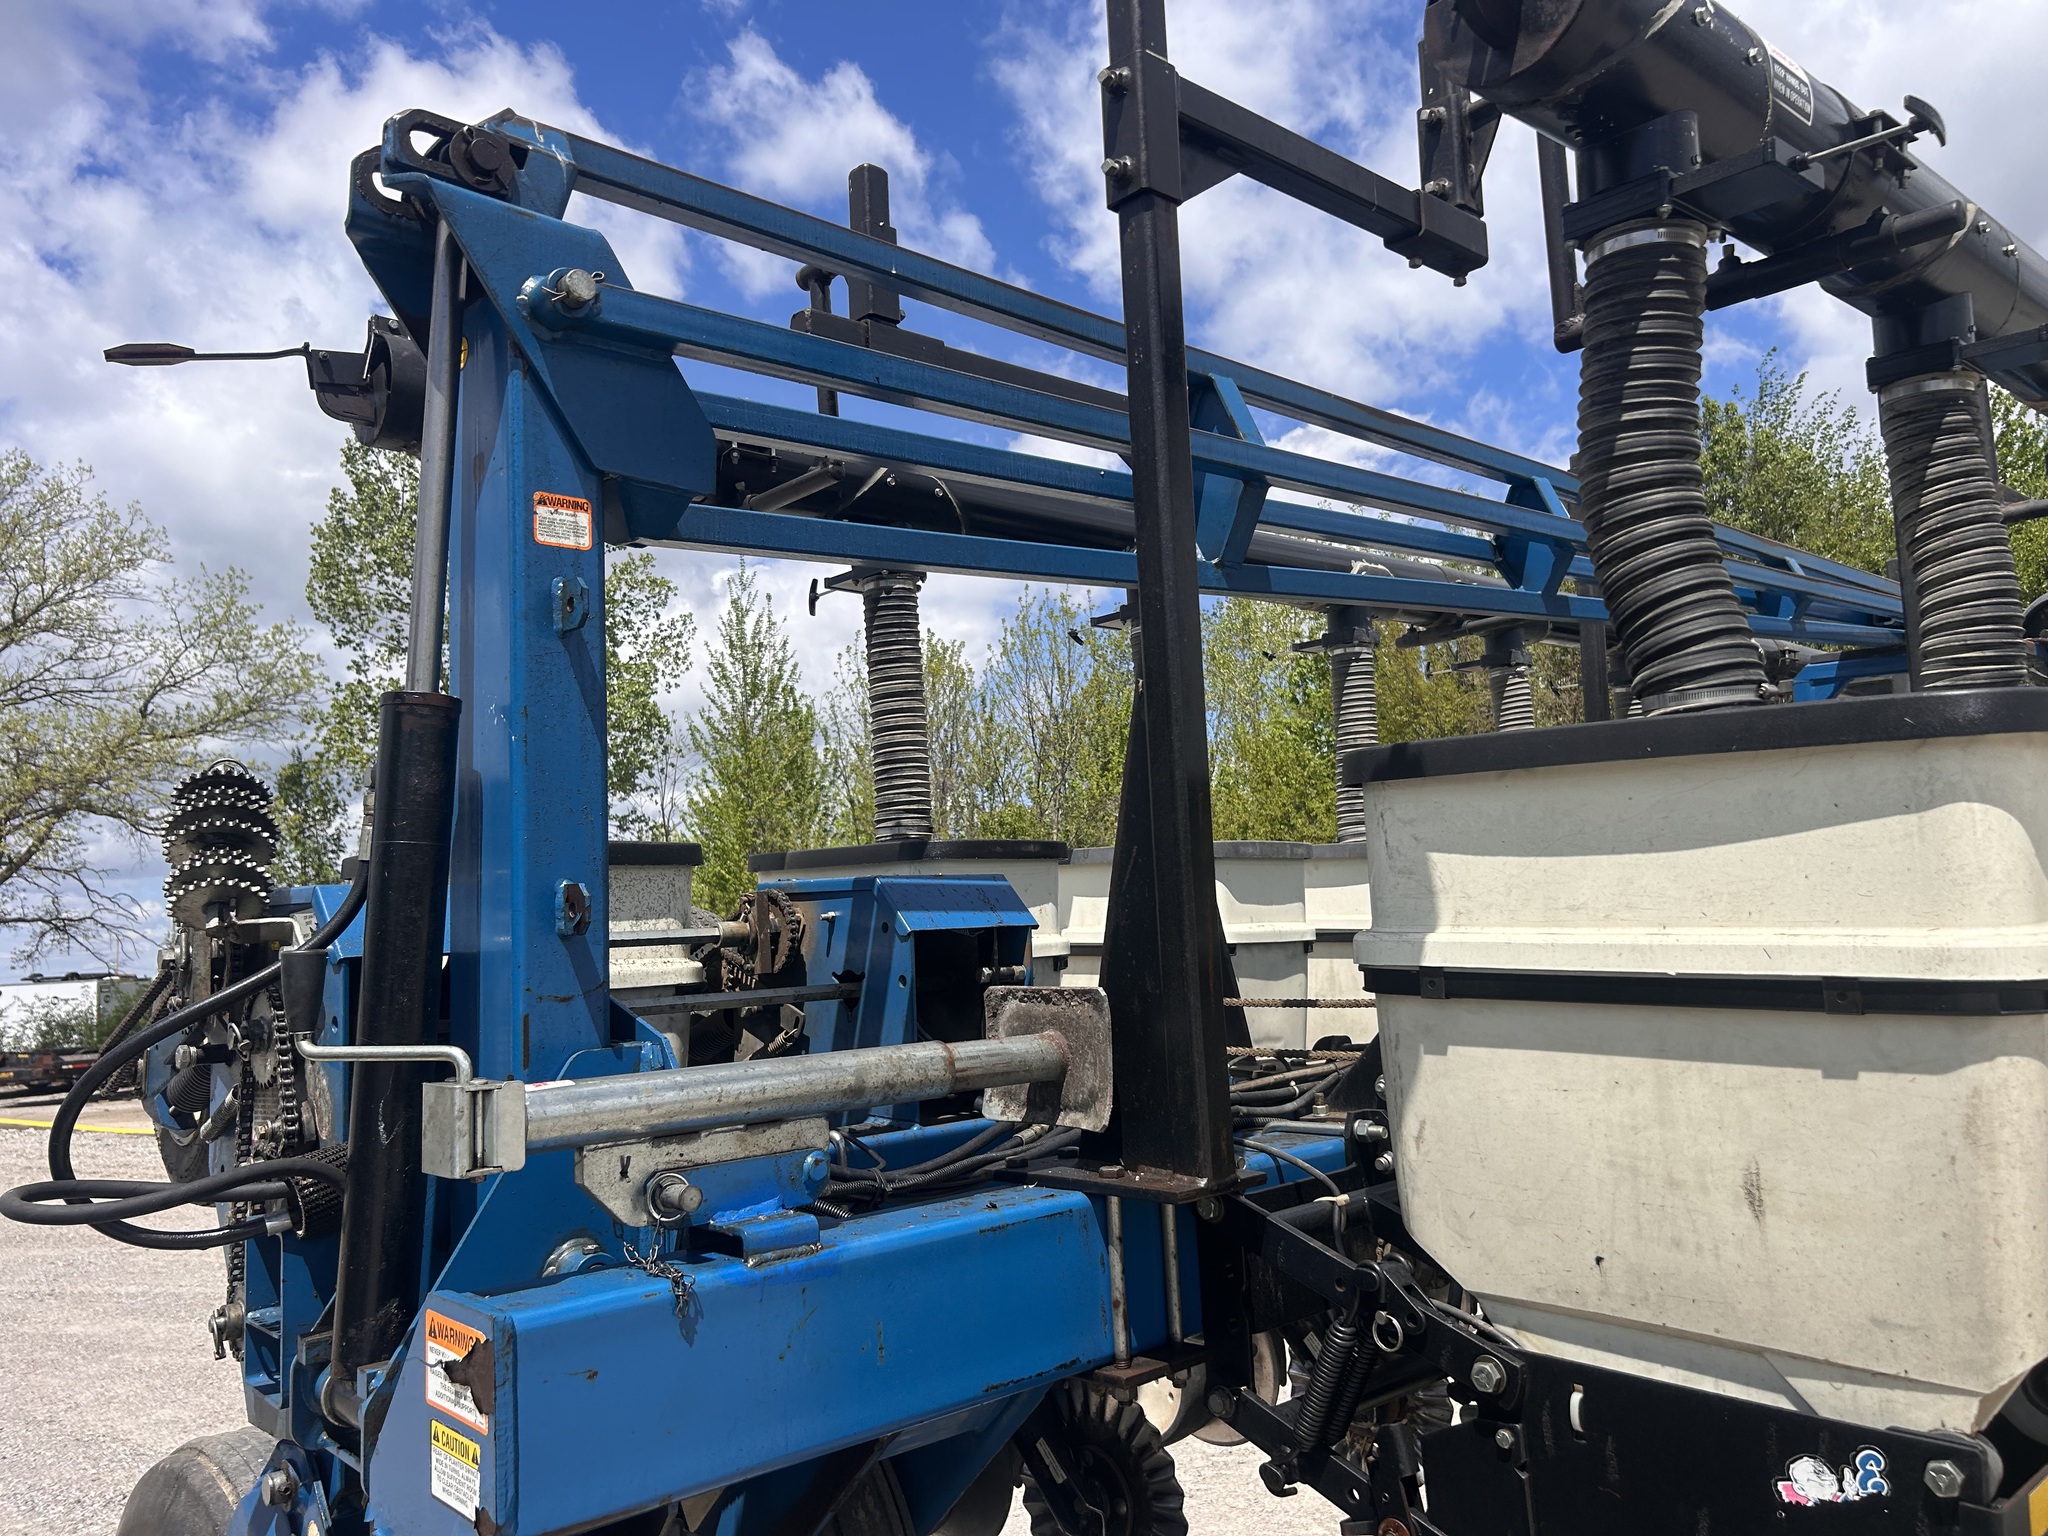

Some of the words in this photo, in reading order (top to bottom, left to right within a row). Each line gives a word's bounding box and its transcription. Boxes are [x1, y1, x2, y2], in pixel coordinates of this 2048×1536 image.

[546, 496, 589, 511] WARNING
[437, 1322, 474, 1352] WARNING
[441, 1431, 470, 1461] CAUTION
